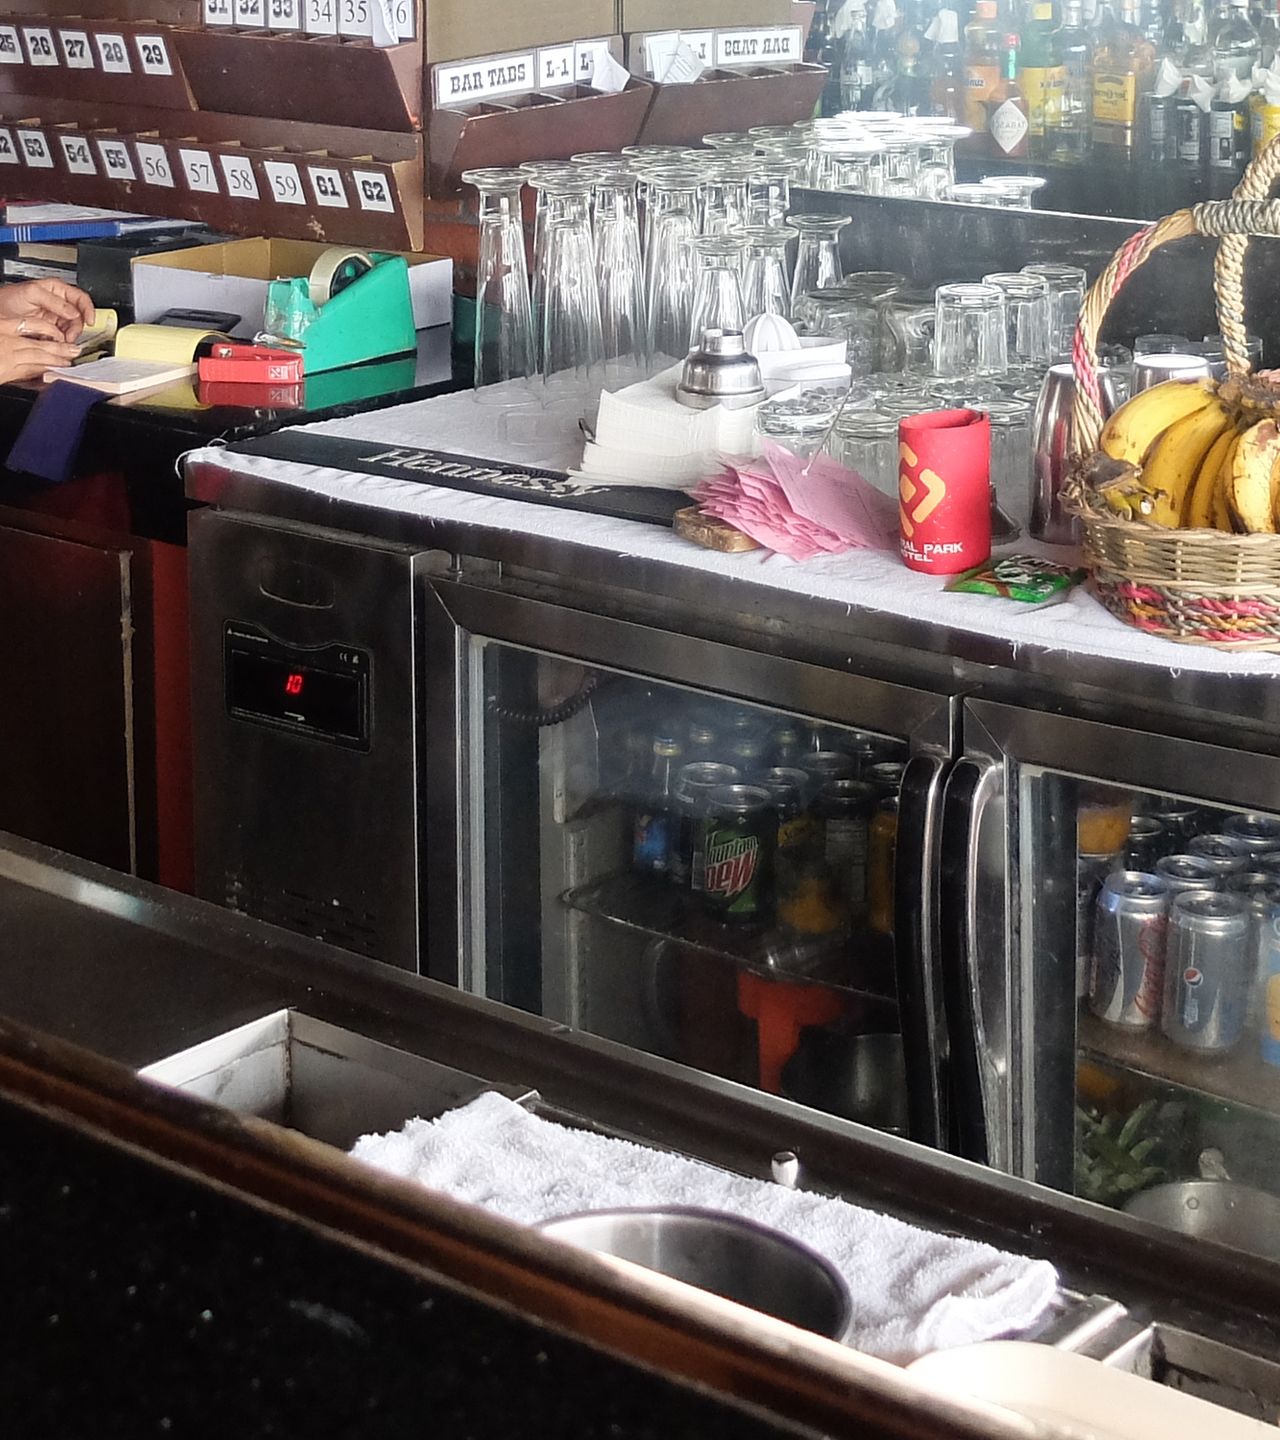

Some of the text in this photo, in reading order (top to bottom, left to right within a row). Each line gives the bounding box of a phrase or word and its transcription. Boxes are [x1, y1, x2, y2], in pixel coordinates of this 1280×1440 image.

[345, 0, 367, 23] 35
[29, 35, 51, 55] 26
[65, 38, 85, 58] 27
[102, 42, 123, 62] 28
[142, 44, 163, 64] 29
[546, 58, 569, 78] L-1
[580, 52, 594, 71] L-
[450, 63, 526, 94] BAR TABS
[25, 138, 45, 158] 53
[66, 144, 90, 163] 54
[105, 149, 126, 169] 55
[144, 158, 167, 178] 56
[189, 163, 210, 184] 57
[230, 169, 253, 191] 58
[275, 175, 298, 197] 59
[357, 448, 612, 498] Hennessy
[923, 542, 963, 554] PARK
[285, 674, 303, 694] 10
